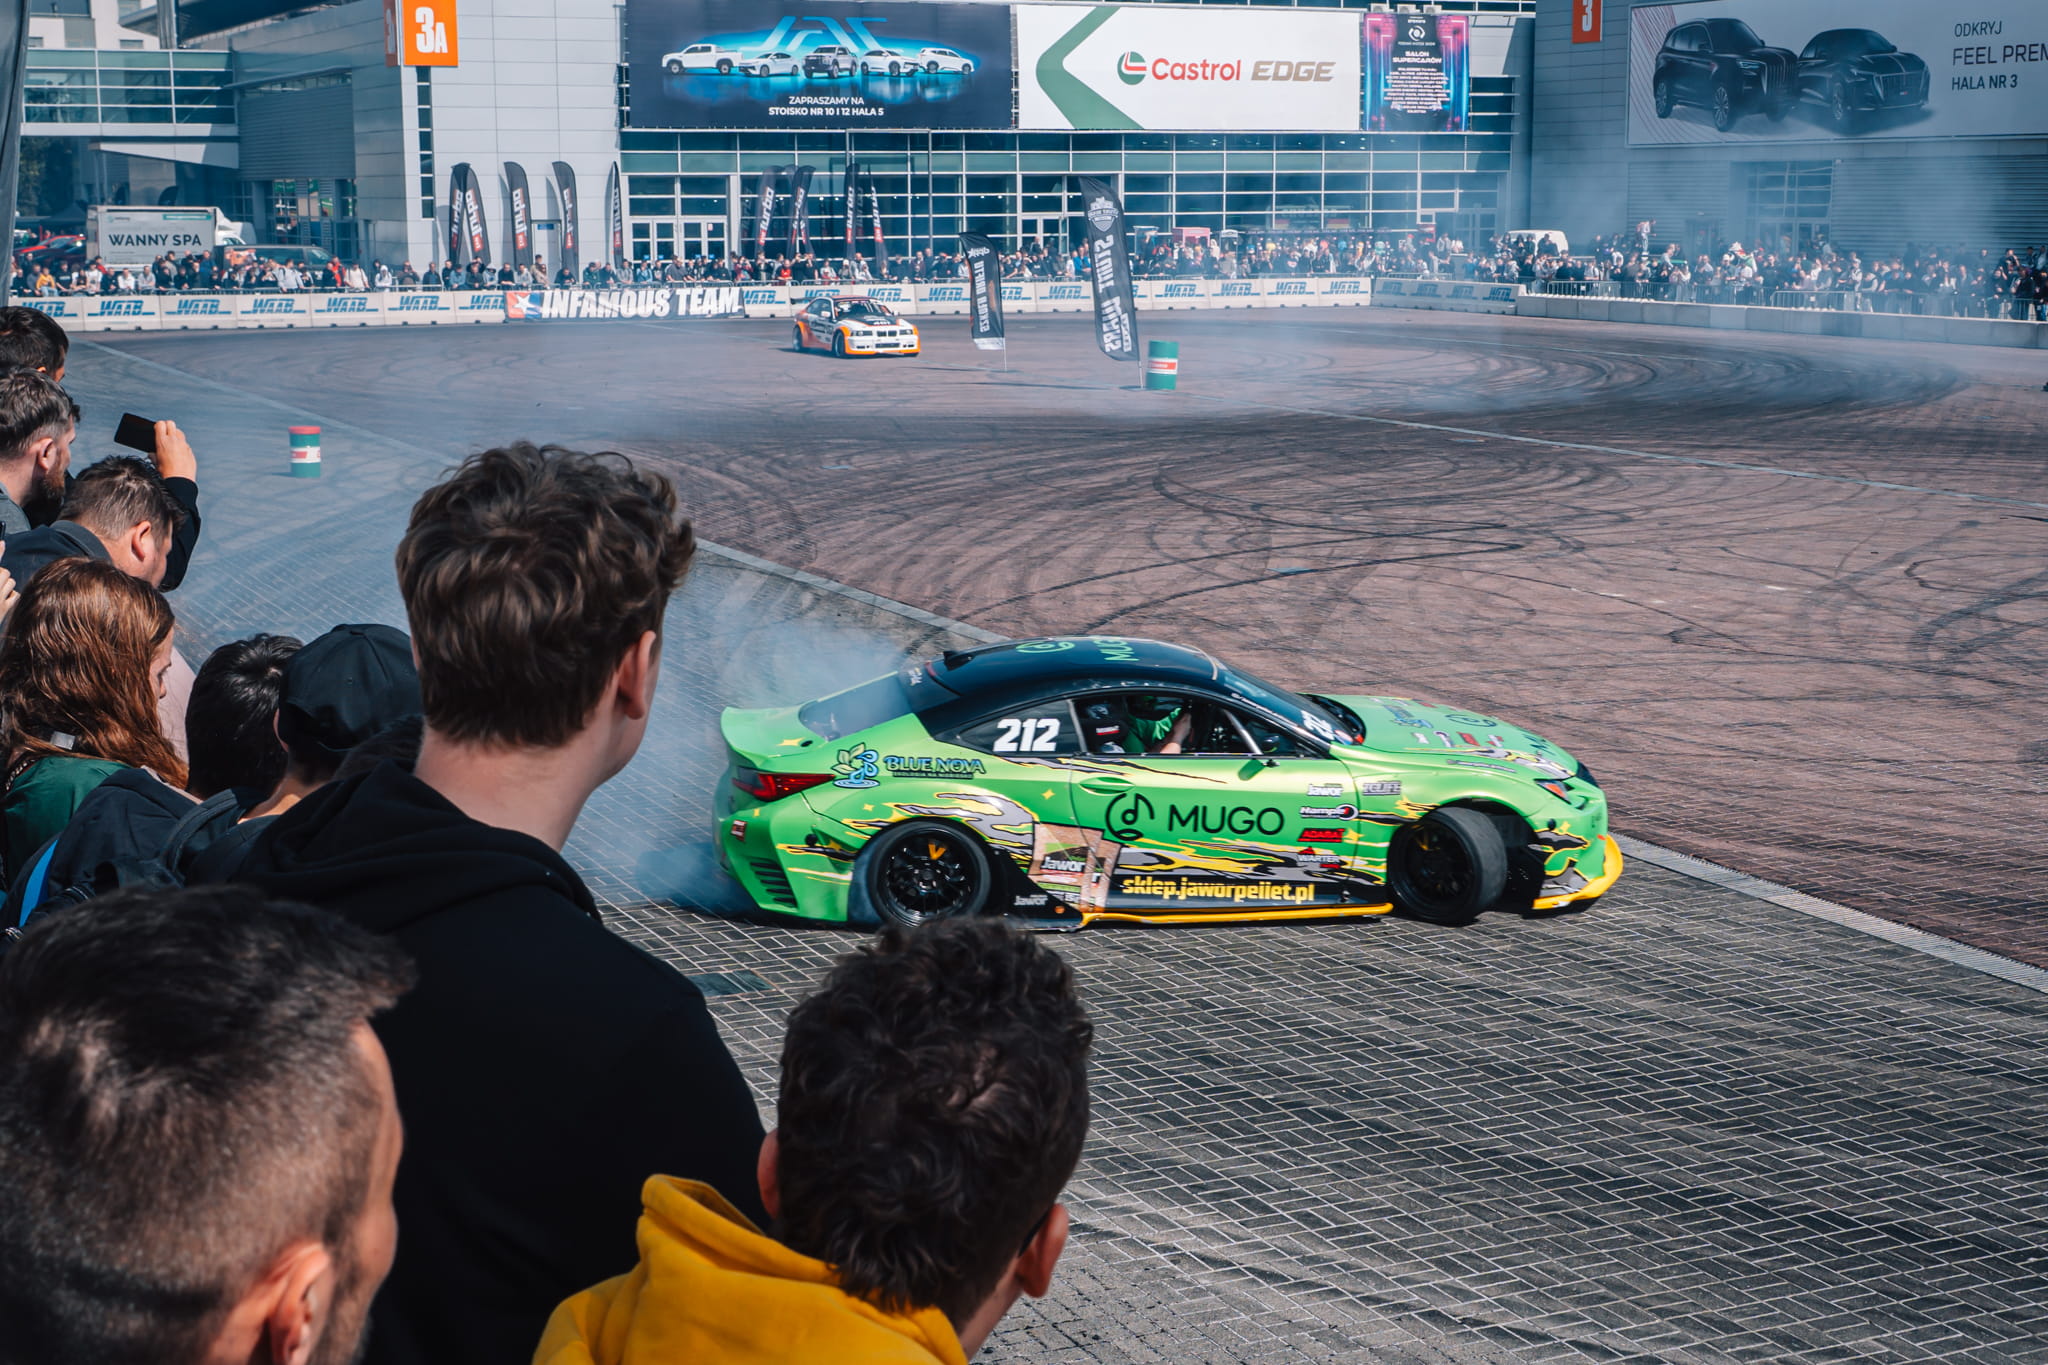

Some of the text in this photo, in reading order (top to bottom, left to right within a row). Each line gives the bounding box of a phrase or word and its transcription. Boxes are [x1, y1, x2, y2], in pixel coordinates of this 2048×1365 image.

[415, 6, 449, 53] 3A
[1954, 20, 2003, 38] ODKRYJ
[1953, 45, 1998, 66] FEEL
[1151, 57, 1337, 82] Castrol EDGE
[1952, 73, 2018, 91] HALA NR 3
[788, 96, 865, 105] ZAPRASZAMY NA
[768, 106, 809, 116] STOISKO
[810, 107, 824, 116] NR
[825, 107, 834, 116] 10
[841, 107, 851, 116] 12
[852, 107, 876, 116] HALA
[878, 108, 884, 116] 5
[108, 234, 202, 247] WANNY SPA
[541, 287, 743, 318] INFAMOUS TEAM
[993, 717, 1061, 752] 212
[884, 755, 986, 775] BLUE NOVA
[1168, 804, 1285, 836] MUGO
[1041, 855, 1087, 872] Jawor
